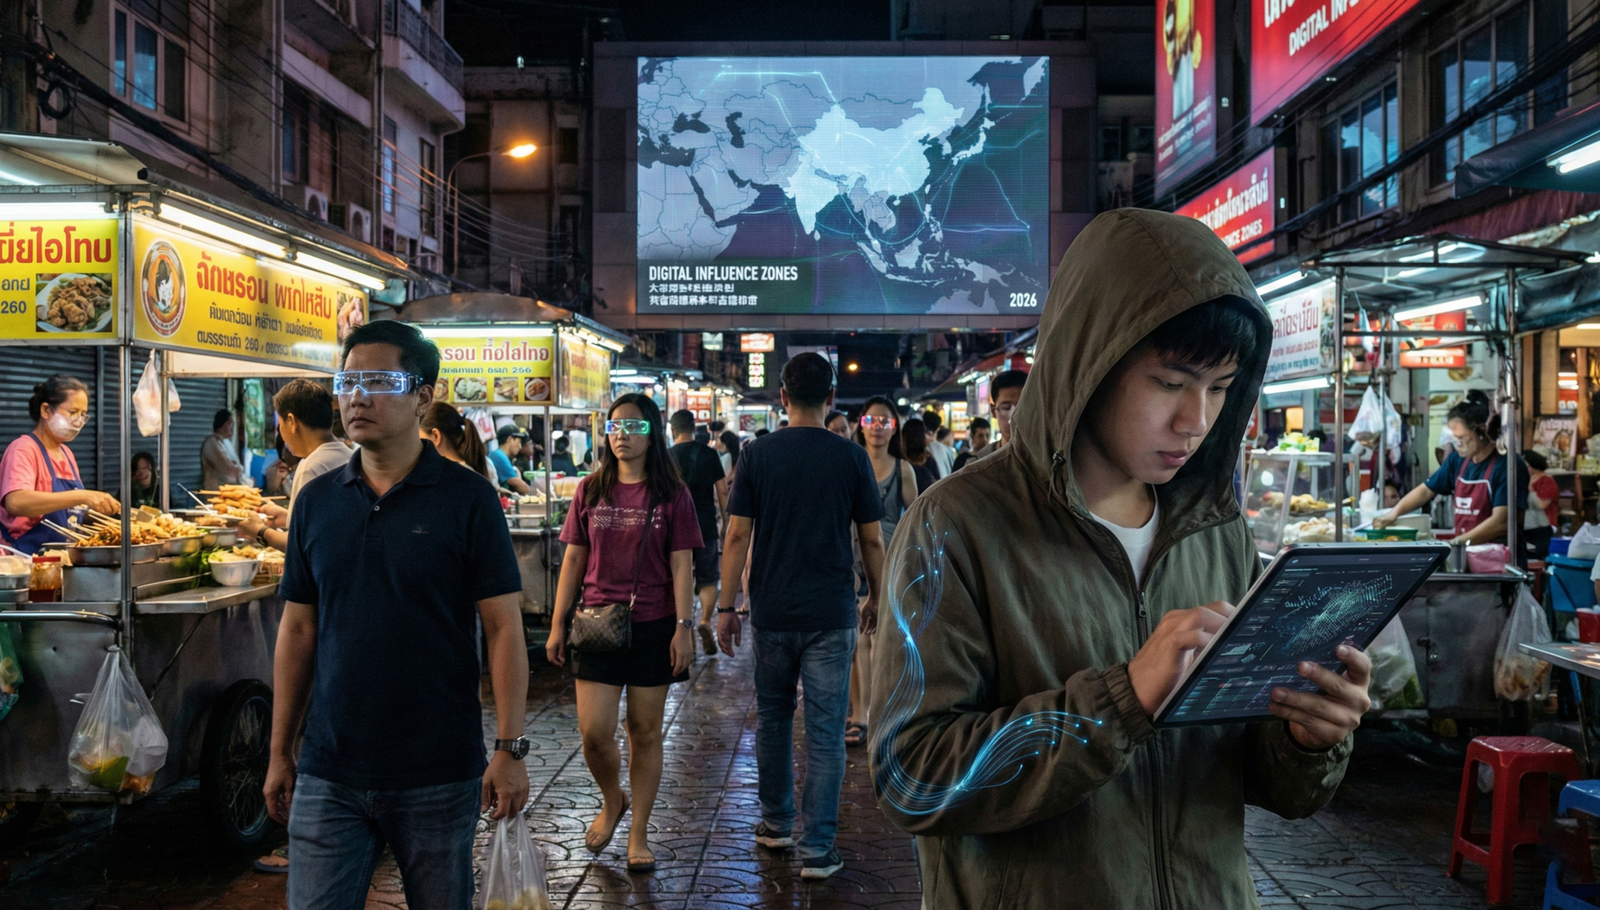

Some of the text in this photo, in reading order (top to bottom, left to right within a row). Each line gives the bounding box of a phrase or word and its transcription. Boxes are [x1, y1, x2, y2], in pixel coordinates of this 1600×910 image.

[1289, 4, 1330, 57] DIGITAL
[649, 265, 799, 281] DIGITAL INFLUENCE ZONES
[0, 300, 27, 314] 260
[1009, 292, 1037, 307] 2026
